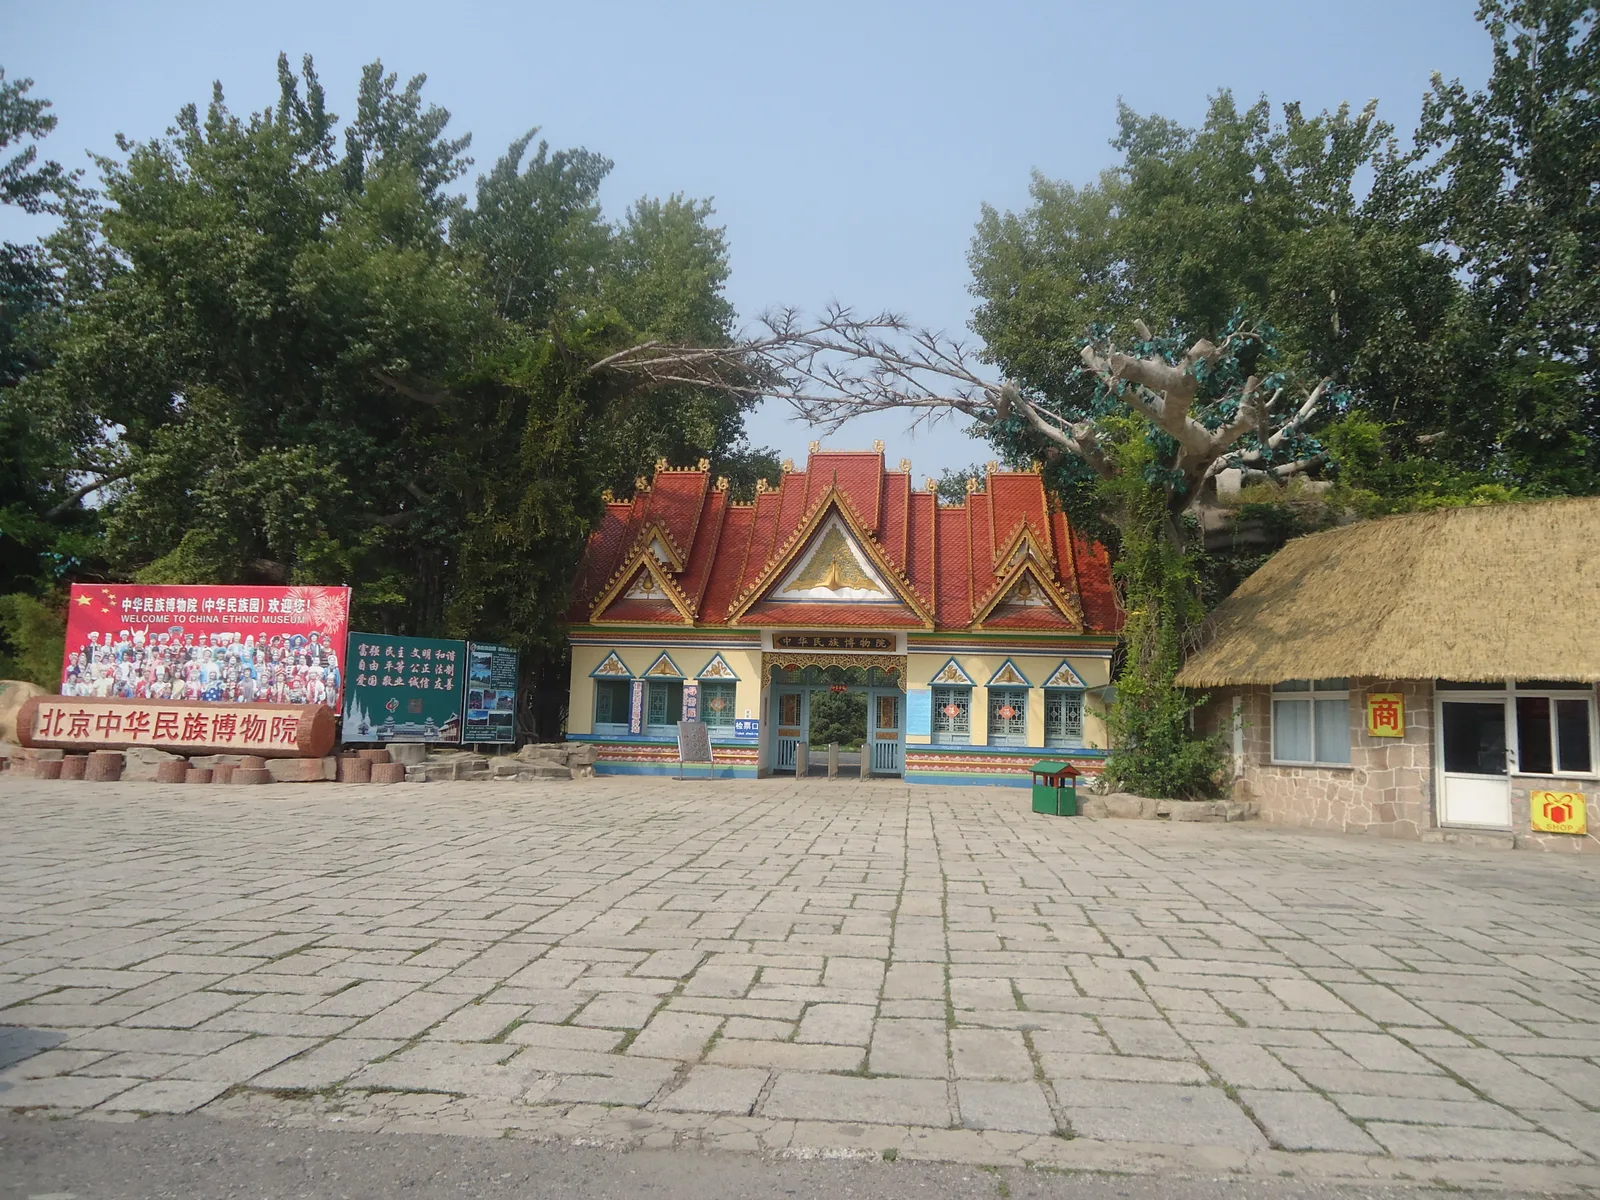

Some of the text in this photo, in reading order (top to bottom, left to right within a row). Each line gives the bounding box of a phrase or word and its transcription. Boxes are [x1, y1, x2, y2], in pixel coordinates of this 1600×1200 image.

[121, 597, 198, 612] 中华民族博物院
[121, 614, 306, 624] WELCOME TO CHINA ETHNIC MUSEUM
[782, 636, 887, 648] 中华民族博物院
[358, 643, 456, 661] 富强 民主 文明 和谐
[358, 659, 379, 671] 自由
[384, 660, 406, 673] 平等
[410, 663, 431, 673] 公正
[1370, 698, 1400, 730] 商
[39, 708, 300, 745] 北京中华民族博物院
[735, 721, 759, 730] 检票口
[1546, 823, 1574, 831] SHOP
